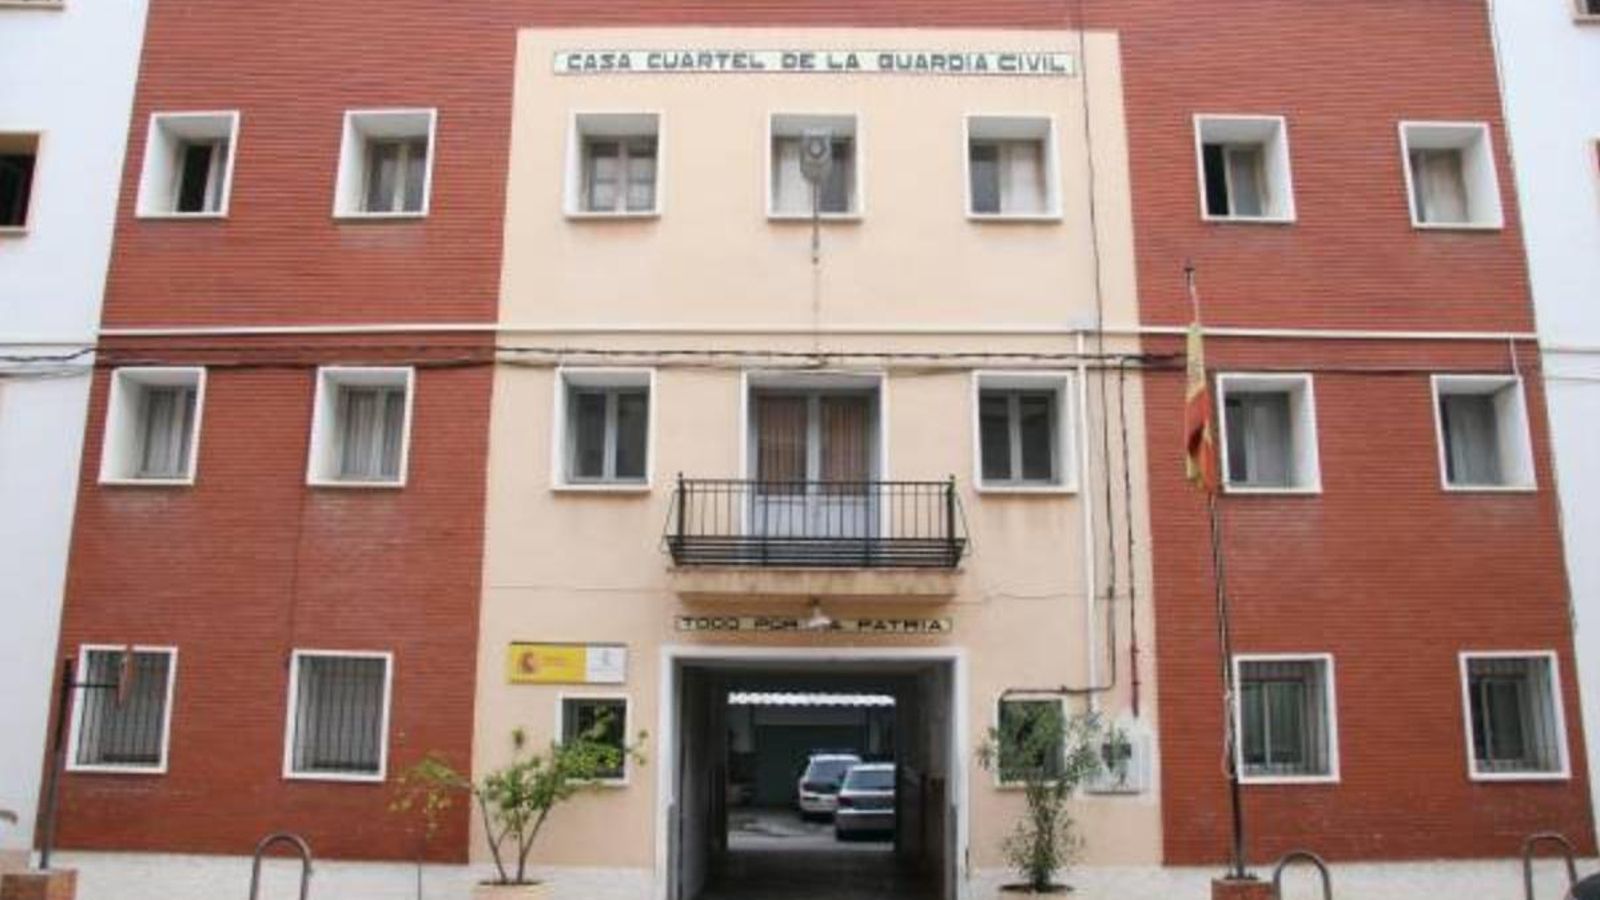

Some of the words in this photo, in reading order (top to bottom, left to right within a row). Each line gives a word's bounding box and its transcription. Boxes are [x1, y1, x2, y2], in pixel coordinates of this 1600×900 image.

[566, 53, 632, 70] CASA
[646, 52, 766, 70] CUARTEL
[781, 53, 816, 69] DE
[826, 53, 861, 69] LA
[877, 53, 989, 71] GUARDIA
[997, 55, 1066, 72] CIVIL
[682, 616, 740, 631] TODO
[858, 618, 942, 631] PATRIA
